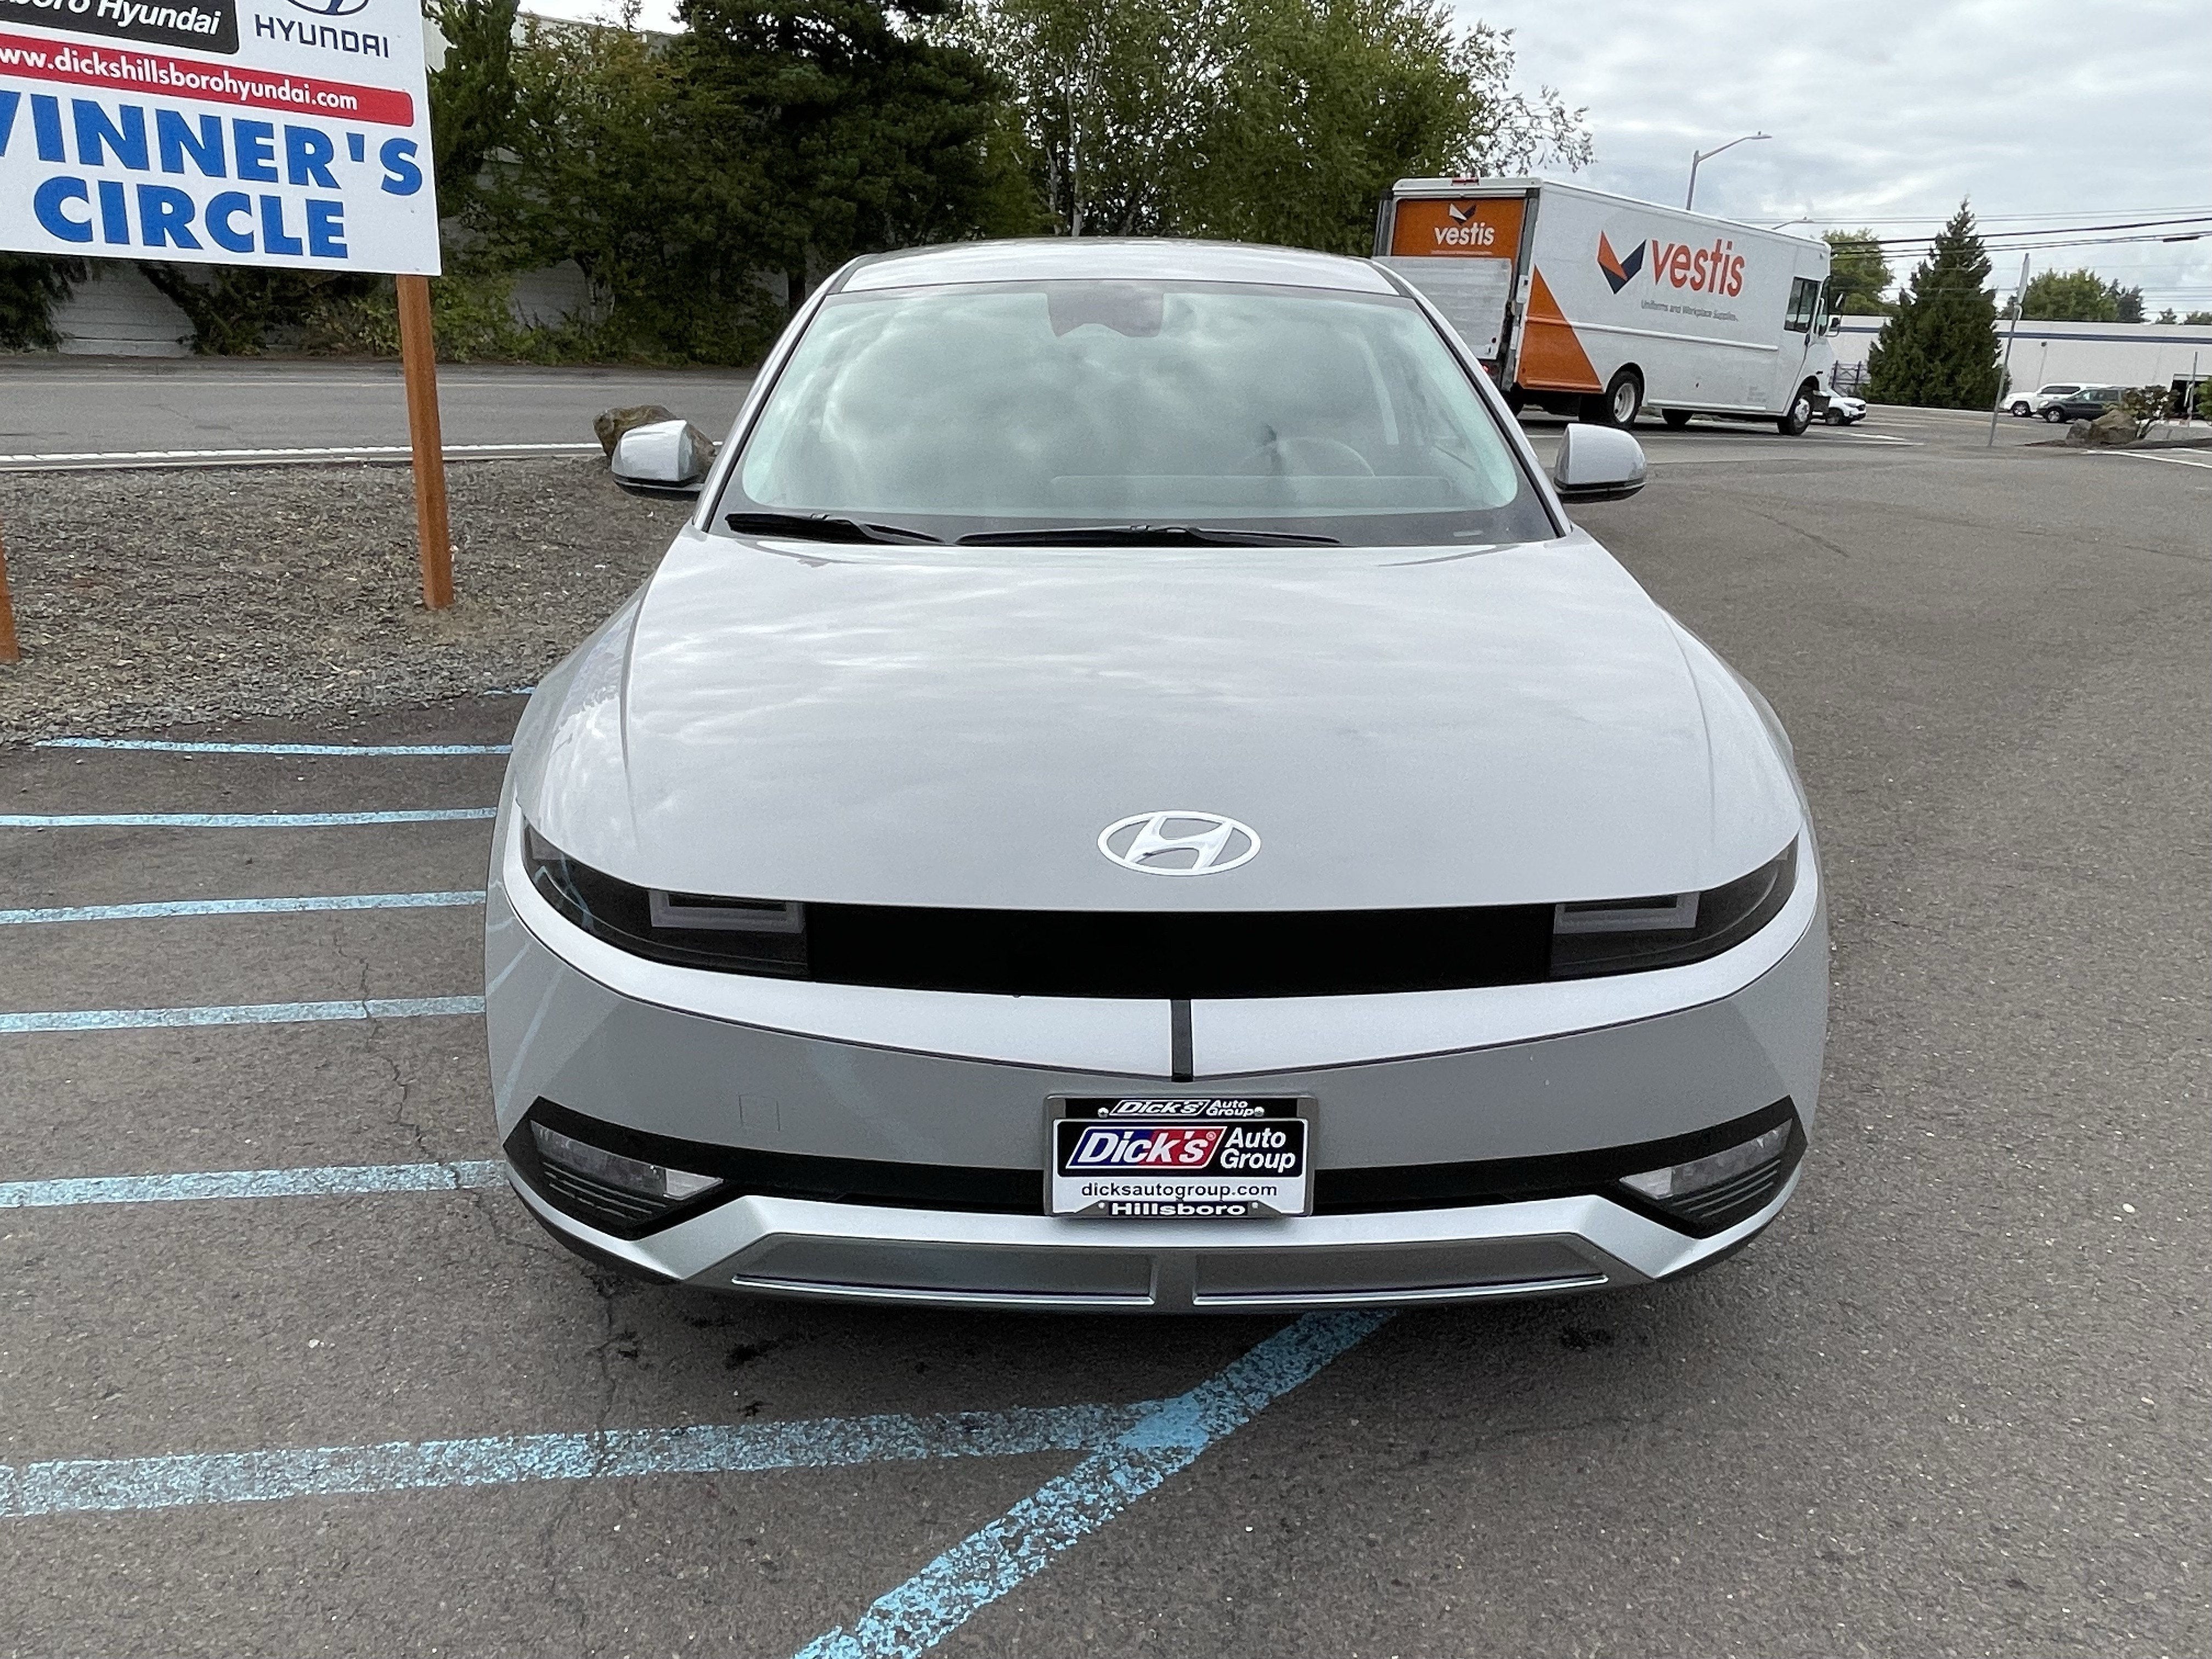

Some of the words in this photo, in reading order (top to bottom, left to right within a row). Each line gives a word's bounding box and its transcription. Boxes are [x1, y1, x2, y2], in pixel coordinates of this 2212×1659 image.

[96, 0, 222, 35] Hyundai
[255, 14, 389, 58] HYUNDAI
[33, 176, 348, 259] CIRCLE
[1434, 222, 1495, 245] vestis
[1651, 238, 1745, 297] vestis
[1206, 1107, 1254, 1117] Group
[1211, 1100, 1249, 1108] Auto
[1224, 1127, 1286, 1148] Auto
[1220, 1149, 1296, 1172] Group
[1081, 1182, 1277, 1201] dicksautogroup.com
[1111, 1203, 1246, 1216] Hillsboro
